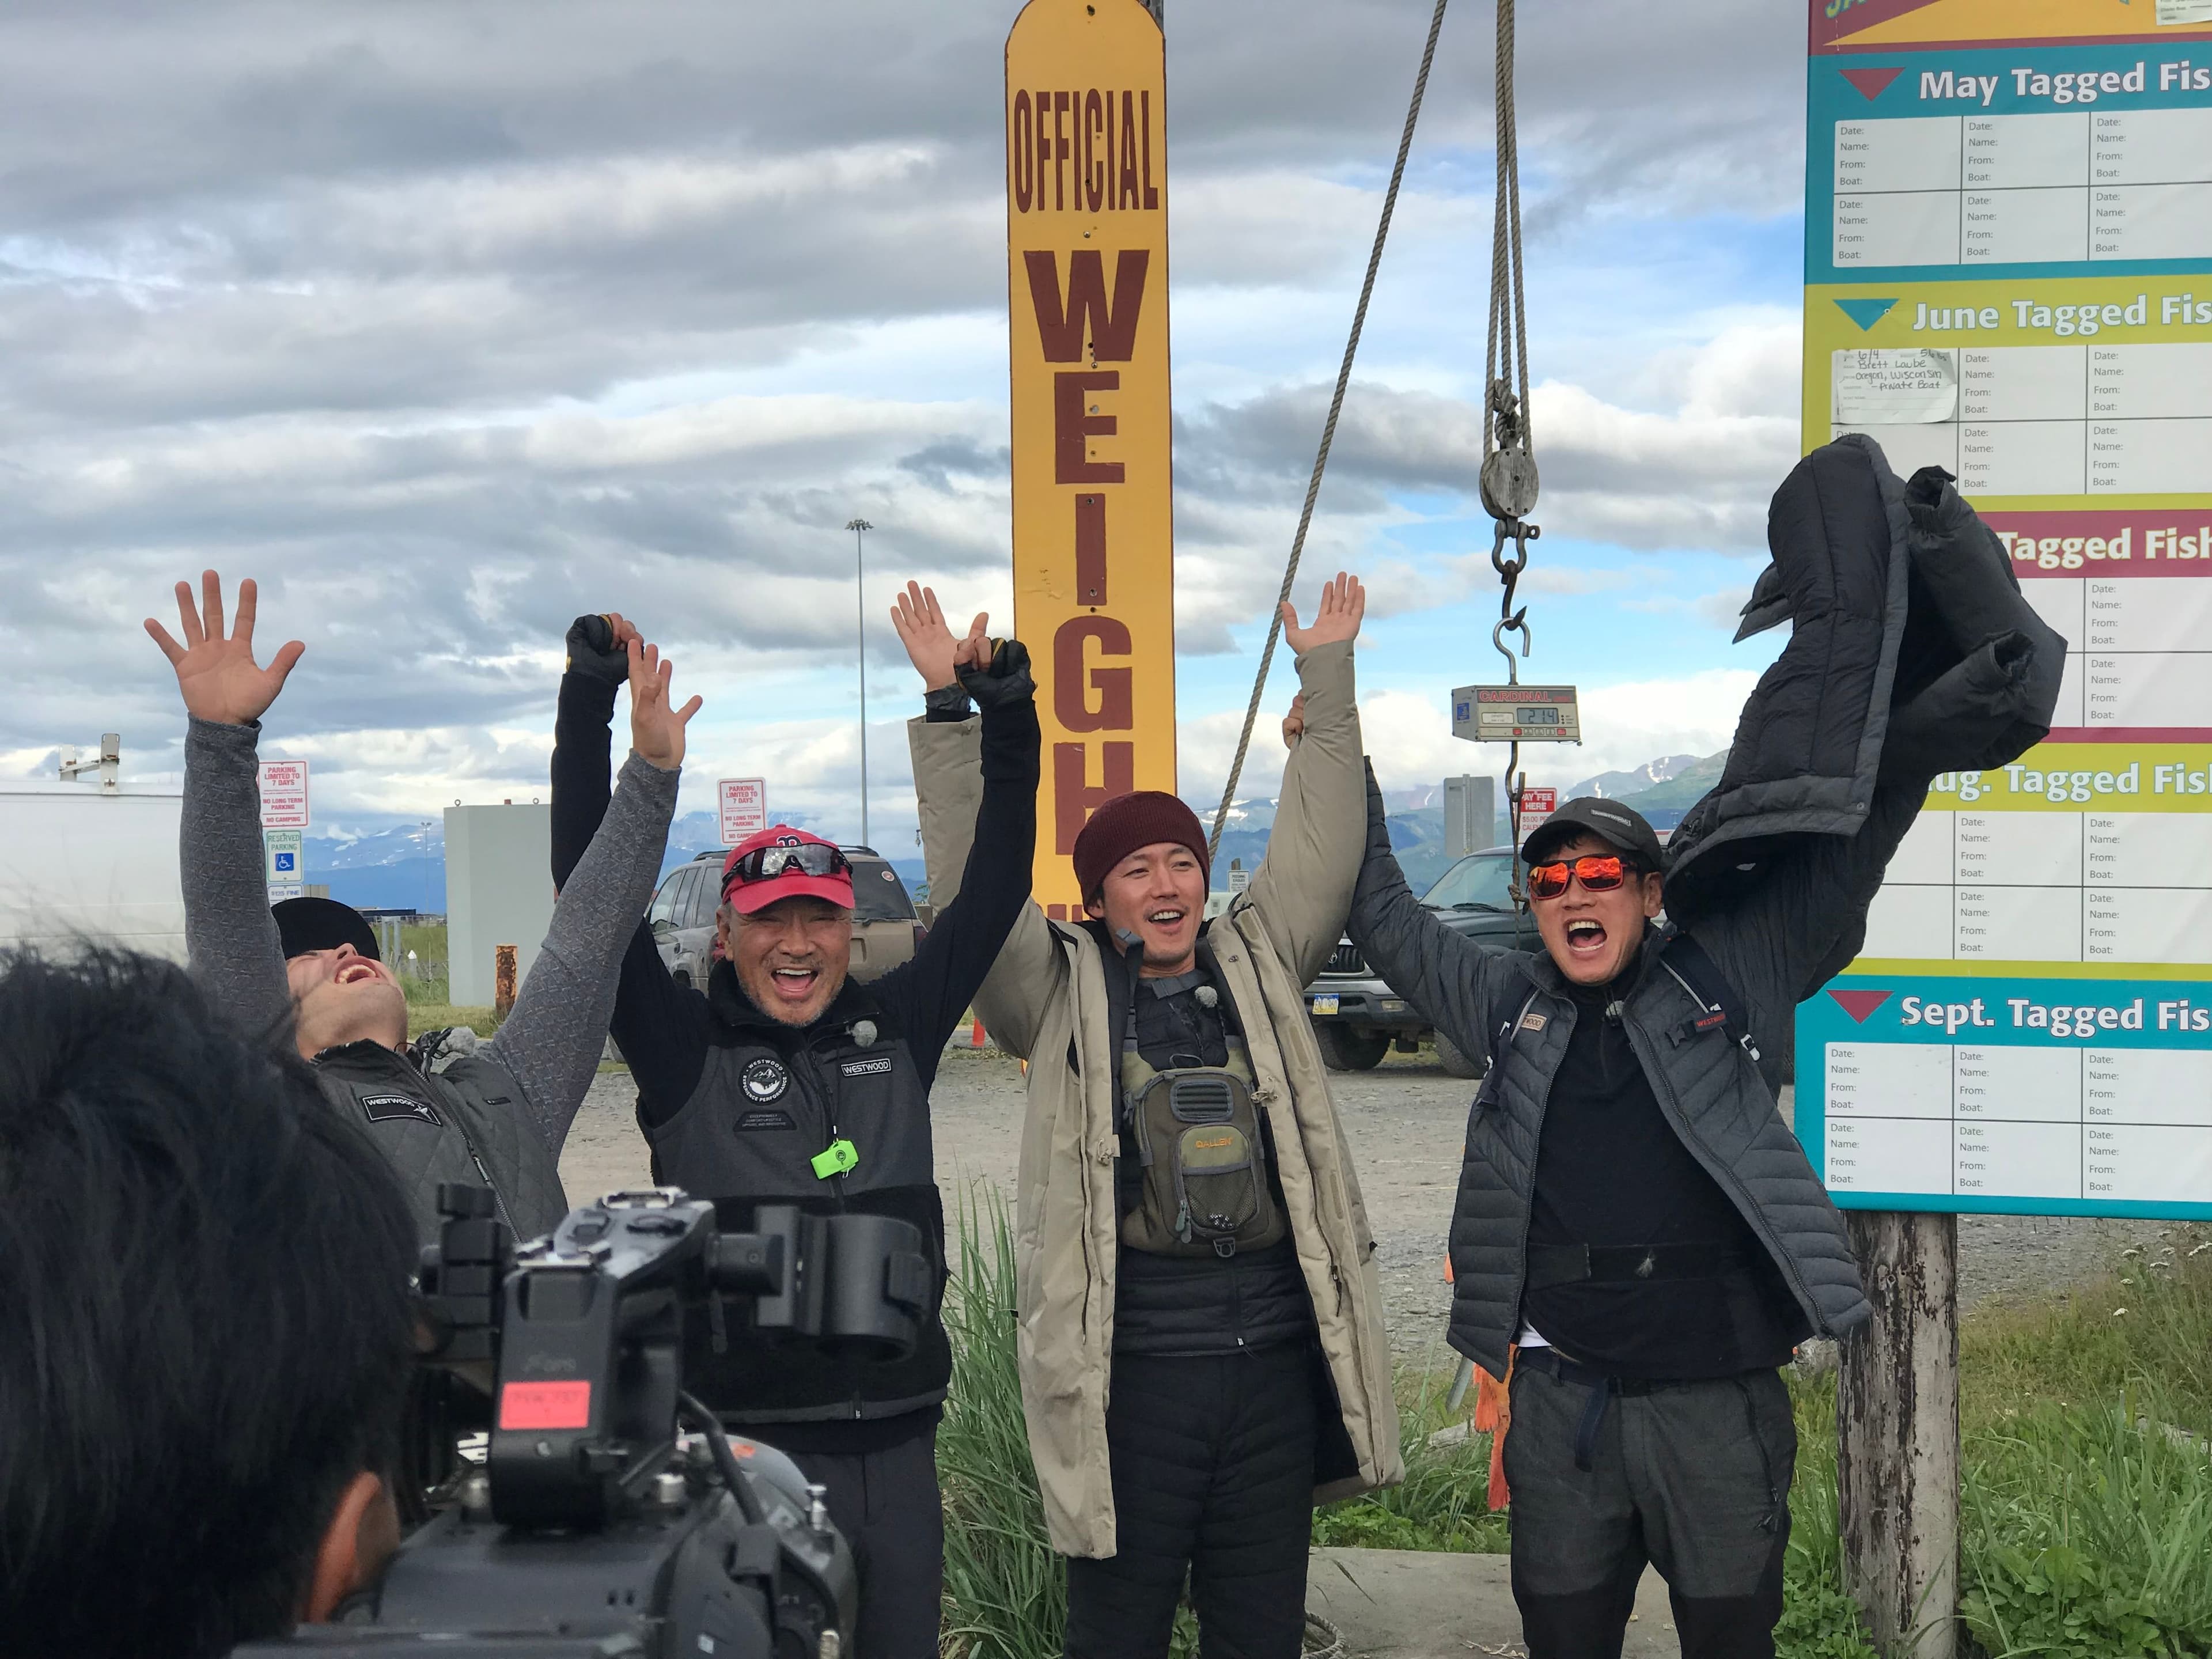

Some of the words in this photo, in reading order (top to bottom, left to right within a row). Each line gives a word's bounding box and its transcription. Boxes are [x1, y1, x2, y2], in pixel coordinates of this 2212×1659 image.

[1919, 71, 1999, 107] May
[2011, 61, 2145, 104] Tagged
[1969, 122, 1993, 131] Date:
[2097, 118, 2121, 127] Date:
[1840, 127, 1864, 135] Date:
[1968, 138, 1998, 147] Name:
[2097, 134, 2126, 143] Name:
[1014, 88, 1158, 213] OFFICIAL
[1840, 142, 1869, 151] Name:
[1968, 156, 1994, 165] From:
[2096, 152, 2123, 161] From:
[1840, 160, 1866, 169] From:
[1968, 173, 1991, 181] Boat:
[2096, 169, 2120, 177] Boat:
[1840, 177, 1862, 185] Boat:
[1968, 196, 1991, 205] Date:
[2096, 192, 2120, 201] Date:
[1839, 200, 1863, 209] Date:
[1967, 212, 1997, 221] Name:
[2096, 209, 2126, 217] Name:
[1839, 216, 1868, 225] Name:
[1967, 230, 1993, 239] From:
[2096, 226, 2122, 235] From:
[1839, 234, 1865, 243] From:
[1967, 247, 1990, 256] Boat:
[2096, 244, 2119, 252] Boat:
[1838, 251, 1862, 259] Boat:
[1913, 302, 1999, 332] June
[2012, 293, 2147, 336] Tagged
[1965, 354, 1990, 363] Date:
[2094, 351, 2119, 360] Date:
[1858, 359, 1889, 369] Brett
[1965, 370, 1994, 379] Name:
[2094, 368, 2124, 376] Name:
[1965, 388, 1991, 397] From:
[2094, 385, 2120, 394] From:
[1965, 405, 1988, 414] Boat:
[2094, 402, 2118, 411] Boat:
[1964, 429, 1988, 437] Date:
[2093, 426, 2118, 435] Date:
[1964, 444, 1994, 453] Name:
[2093, 442, 2123, 451] Name:
[1964, 462, 1990, 471] From:
[2093, 460, 2120, 469] From:
[1964, 479, 1987, 488] Boat:
[2093, 478, 2116, 486] Boat:
[1995, 527, 2131, 570] Tagged
[2092, 585, 2116, 593] Date:
[2092, 600, 2122, 609] Name:
[2092, 619, 2118, 627] From:
[2092, 635, 2115, 644] Boat:
[2091, 659, 2116, 668] Date:
[2090, 675, 2121, 684] Name:
[1479, 690, 1552, 702] CARDINAL
[2090, 693, 2117, 702] From:
[2090, 710, 2115, 719] Boat:
[1928, 770, 1991, 801] ug.
[2004, 762, 2139, 802] Tagged
[2154, 762, 2212, 794] Fis
[1537, 793, 1552, 801] FEE
[1525, 802, 1547, 810] HERE
[1961, 817, 1985, 827] Date:
[2090, 819, 2115, 828] Date:
[1961, 834, 1990, 842] Name:
[2090, 835, 2120, 844] Name:
[1961, 851, 1987, 860] From:
[2090, 853, 2116, 862] From:
[1960, 868, 1984, 877] Boat:
[2089, 870, 2113, 879] Boat:
[1960, 892, 1984, 901] Date:
[2089, 893, 2114, 903] Date:
[1960, 908, 1990, 917] Name:
[2089, 910, 2120, 919] Name:
[1960, 926, 1986, 935] From:
[2089, 927, 2116, 937] From:
[1960, 943, 1983, 952] Boat:
[2089, 945, 2113, 954] Boat:
[1902, 996, 1994, 1035] Sept.
[2008, 997, 2143, 1037] Tagged
[1831, 1048, 1855, 1058] Date:
[1960, 1051, 1984, 1060] Date:
[2089, 1055, 2113, 1064] Date:
[748, 1059, 783, 1071] WESTWOOD
[843, 1061, 889, 1074] WESTWOOD
[1831, 1065, 1860, 1074] Name:
[1960, 1067, 1990, 1077] Name:
[2089, 1071, 2119, 1080] Name:
[759, 1076, 787, 1102] PERFORMANCE
[1831, 1082, 1857, 1092] From:
[1960, 1085, 1986, 1095] From:
[2089, 1089, 2116, 1099] From:
[366, 1098, 415, 1107] WESTWOOD
[1831, 1099, 1854, 1109] Boat:
[1960, 1103, 1983, 1112] Boat:
[2089, 1106, 2113, 1115] Boat:
[1830, 1123, 1854, 1132] Date:
[1960, 1126, 1984, 1136] Date:
[2089, 1130, 2113, 1139] Date:
[1831, 1139, 1859, 1149] Name:
[1960, 1143, 1990, 1152] Name:
[2089, 1146, 2119, 1156] Name:
[1831, 1157, 1856, 1166] From:
[1960, 1161, 1986, 1171] From:
[2089, 1164, 2116, 1174] From:
[1830, 1174, 1853, 1183] Boat:
[1960, 1177, 1983, 1187] Boat:
[2089, 1181, 2113, 1191] Boat:
